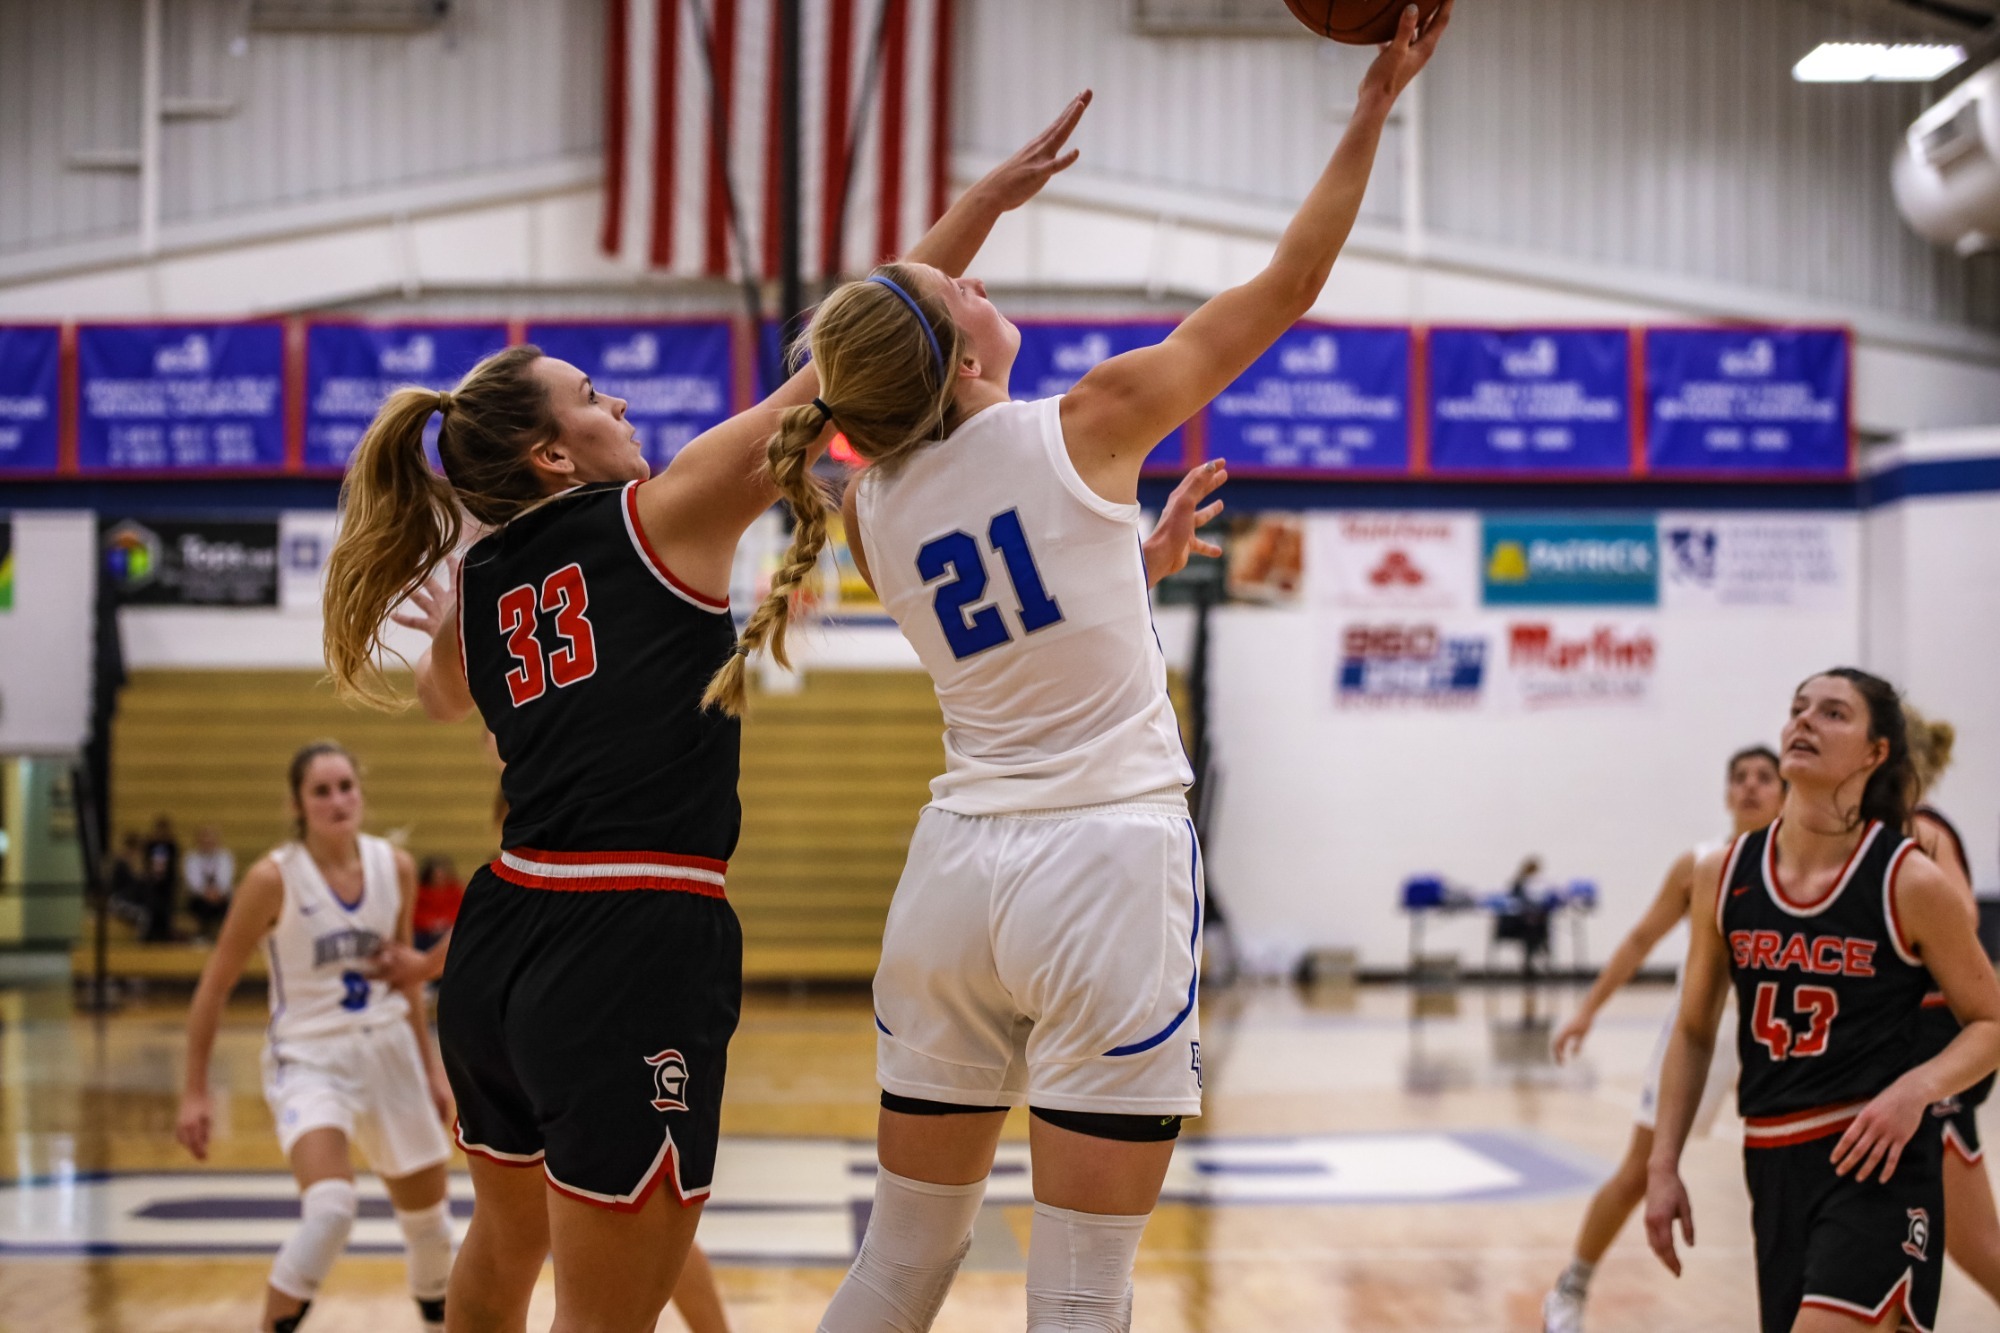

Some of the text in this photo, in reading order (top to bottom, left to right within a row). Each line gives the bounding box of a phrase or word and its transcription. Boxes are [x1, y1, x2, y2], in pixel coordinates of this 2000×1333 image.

[499, 562, 597, 708] 33
[914, 506, 1064, 662] 21
[1730, 929, 1878, 977] GRACE
[1752, 982, 1839, 1062] 43
